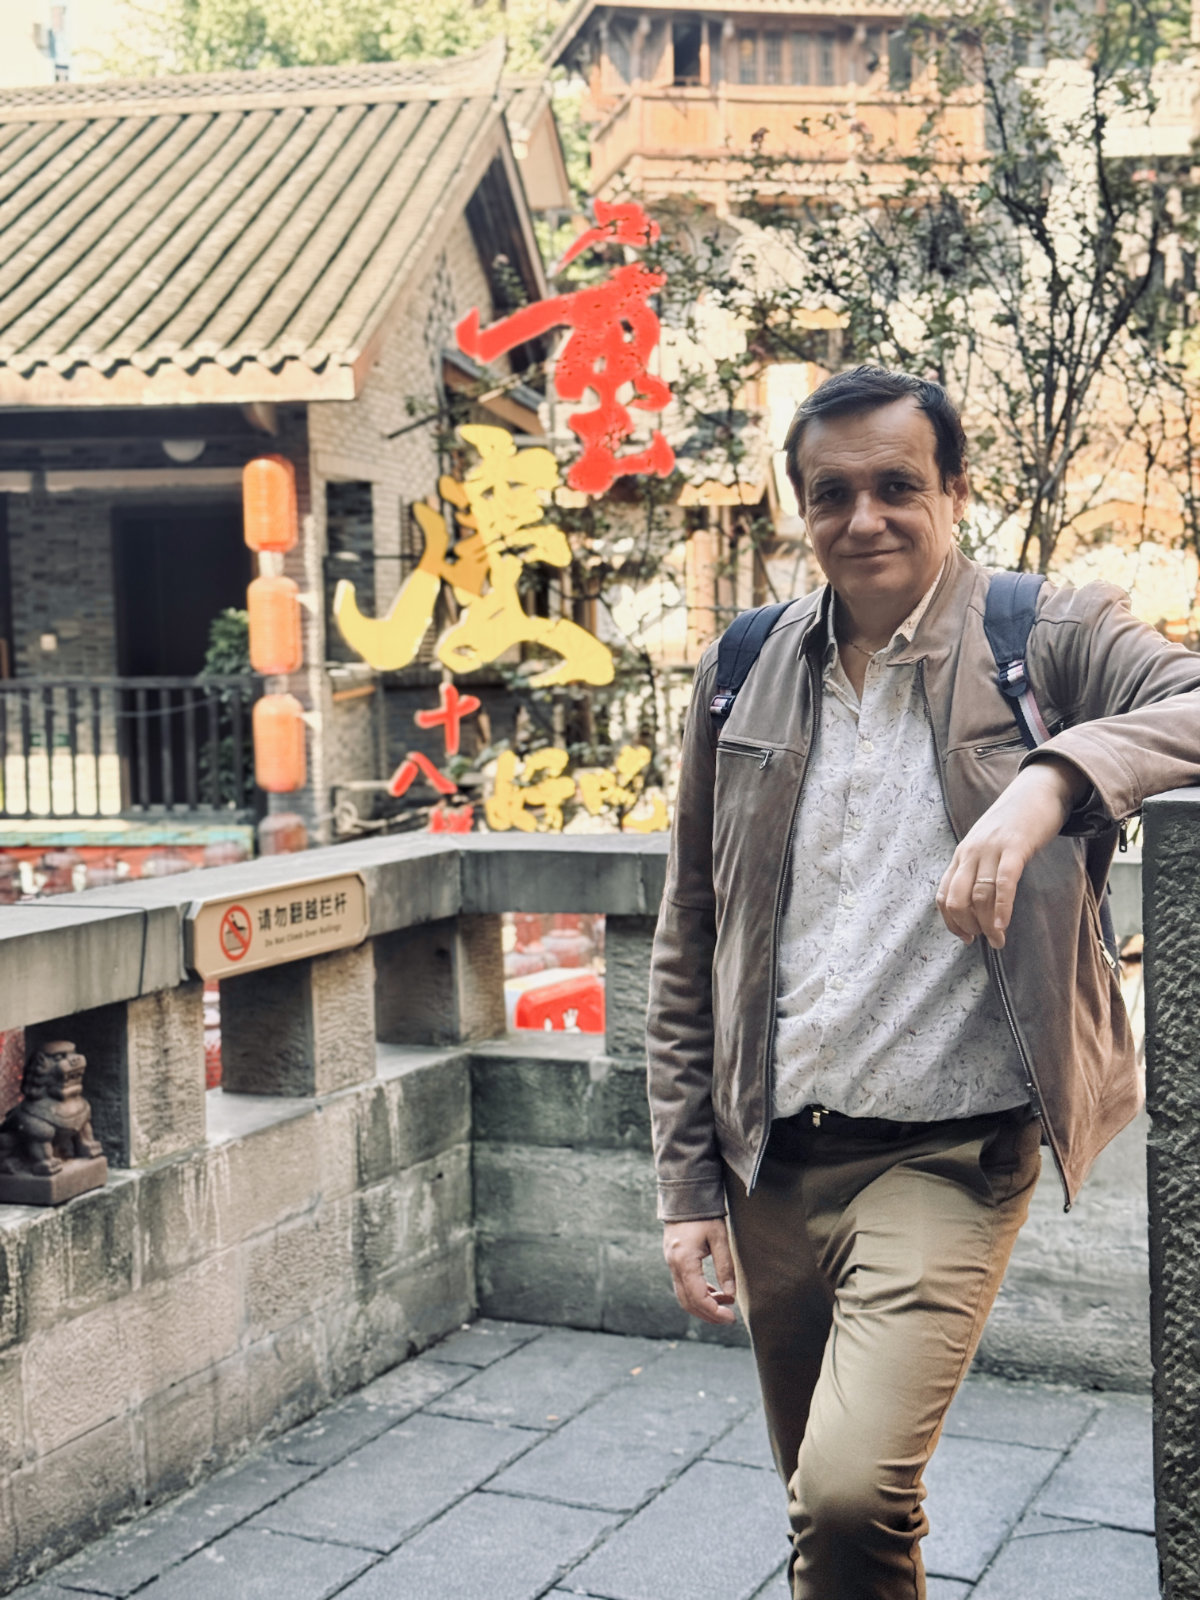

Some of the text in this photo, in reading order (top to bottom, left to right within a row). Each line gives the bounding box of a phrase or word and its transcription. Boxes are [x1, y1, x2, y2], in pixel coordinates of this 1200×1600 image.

[258, 893, 347, 930] 请勿翻越栏杆
[265, 939, 273, 948] Do
[275, 936, 285, 945] Not
